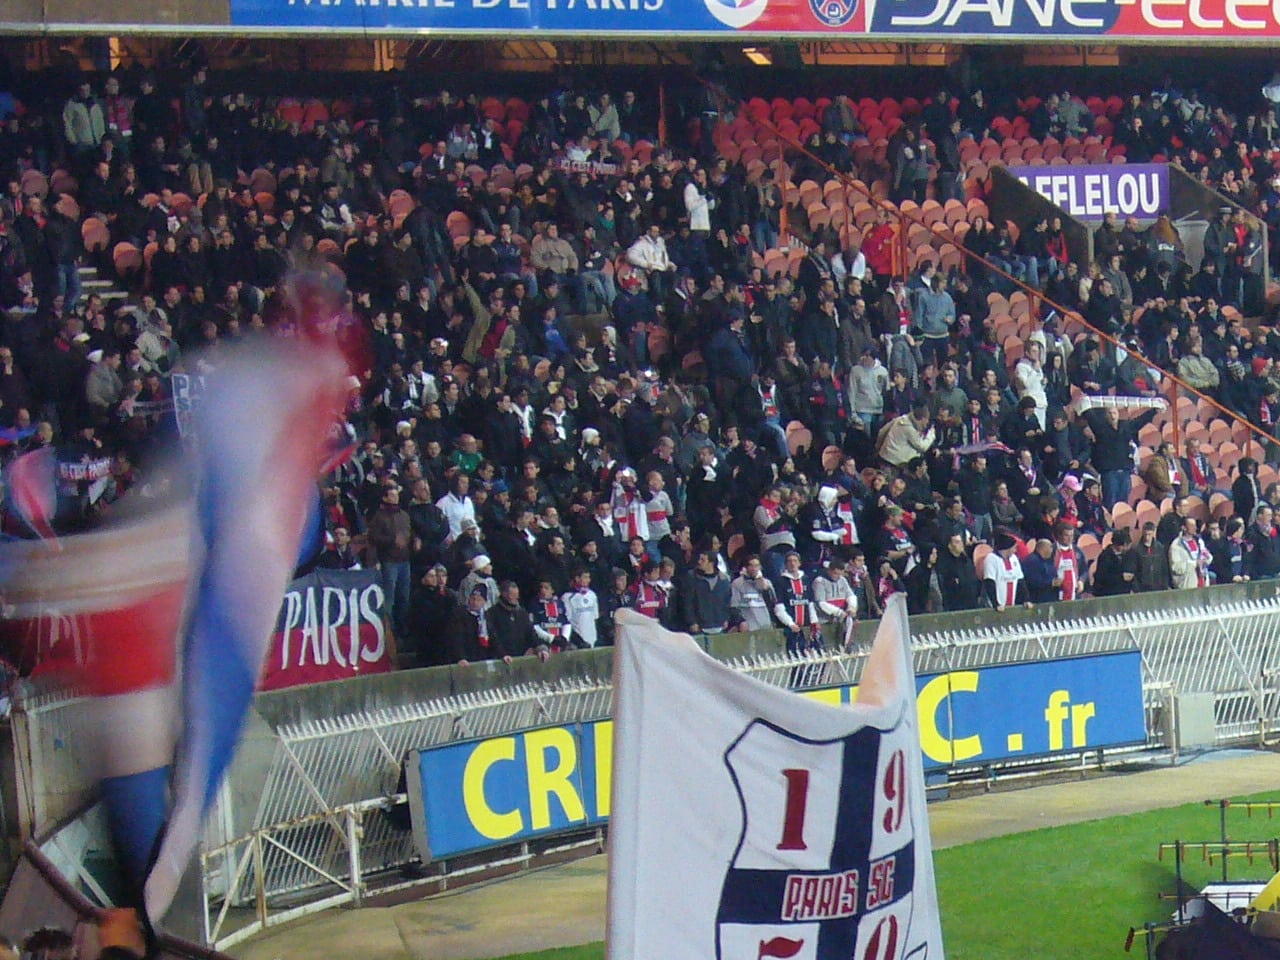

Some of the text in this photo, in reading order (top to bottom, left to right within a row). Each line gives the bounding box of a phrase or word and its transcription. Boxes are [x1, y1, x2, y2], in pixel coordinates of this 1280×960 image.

[1019, 173, 1160, 215] FFLELOU
[281, 583, 386, 670] PARIS
[782, 855, 896, 921] PARIS SG
